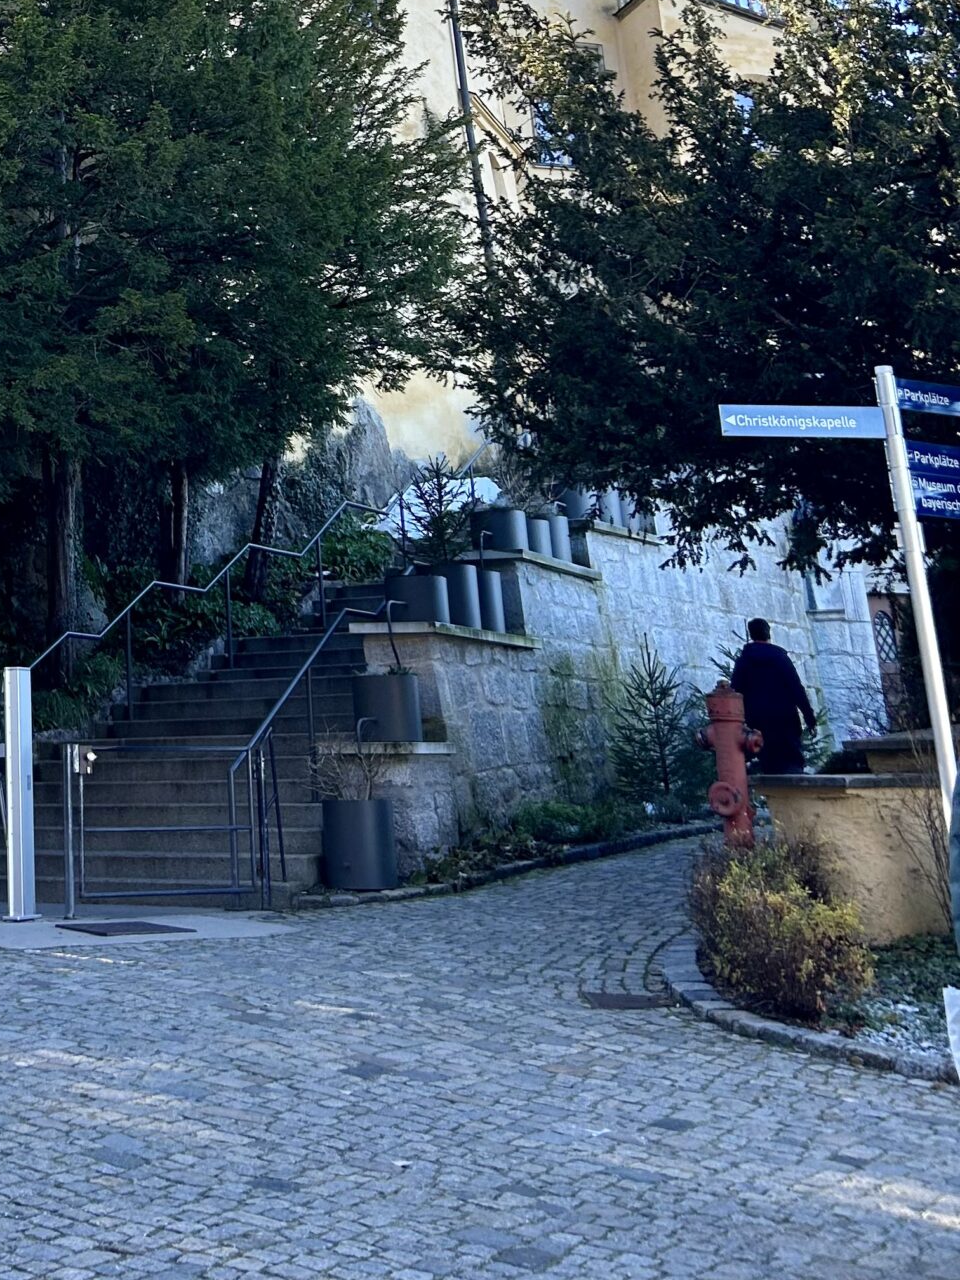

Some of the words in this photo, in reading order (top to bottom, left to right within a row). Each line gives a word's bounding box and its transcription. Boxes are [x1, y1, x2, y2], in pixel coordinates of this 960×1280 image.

[904, 388, 950, 407] Parkplätze
[736, 414, 857, 430] Christkönigskapelle
[914, 450, 959, 469] Parkplätze
[918, 477, 956, 493] Museum
